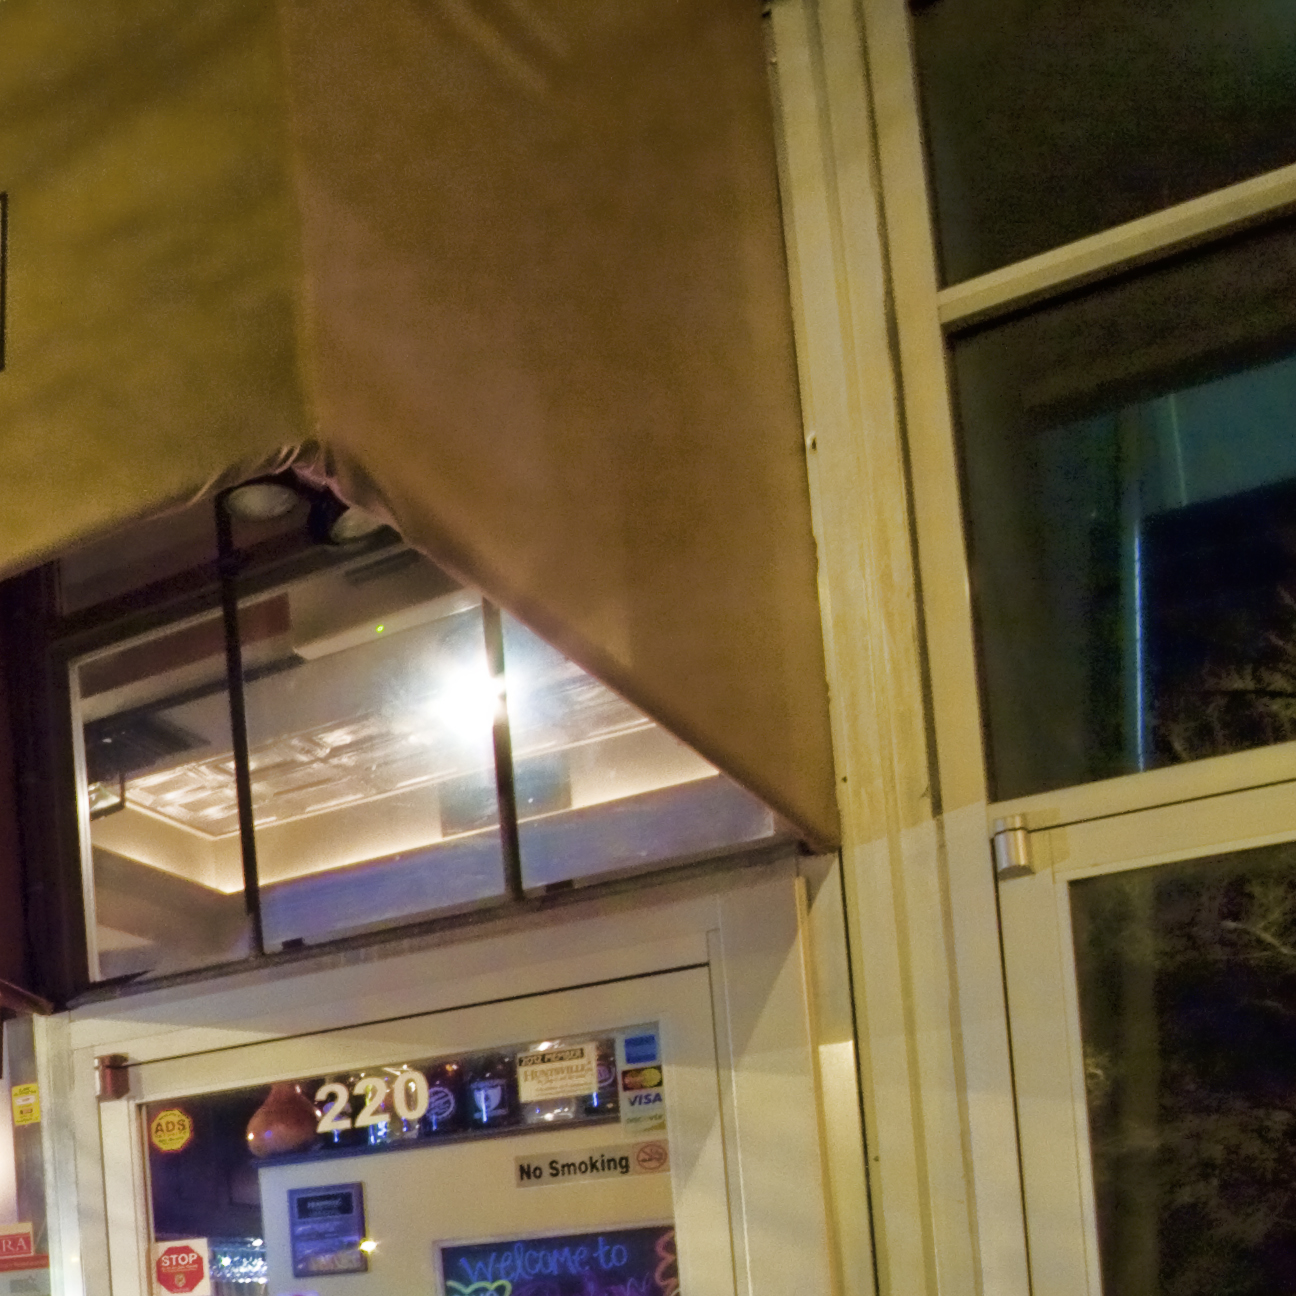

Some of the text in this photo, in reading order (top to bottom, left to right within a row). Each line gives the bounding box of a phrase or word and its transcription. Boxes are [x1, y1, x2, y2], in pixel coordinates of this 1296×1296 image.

[314, 1068, 430, 1134] 220
[628, 1092, 663, 1107] VISA
[154, 1118, 187, 1134] ADS
[518, 1153, 631, 1181] No Smoking
[160, 1252, 198, 1267] STOP
[460, 1236, 629, 1283] Welcome to
